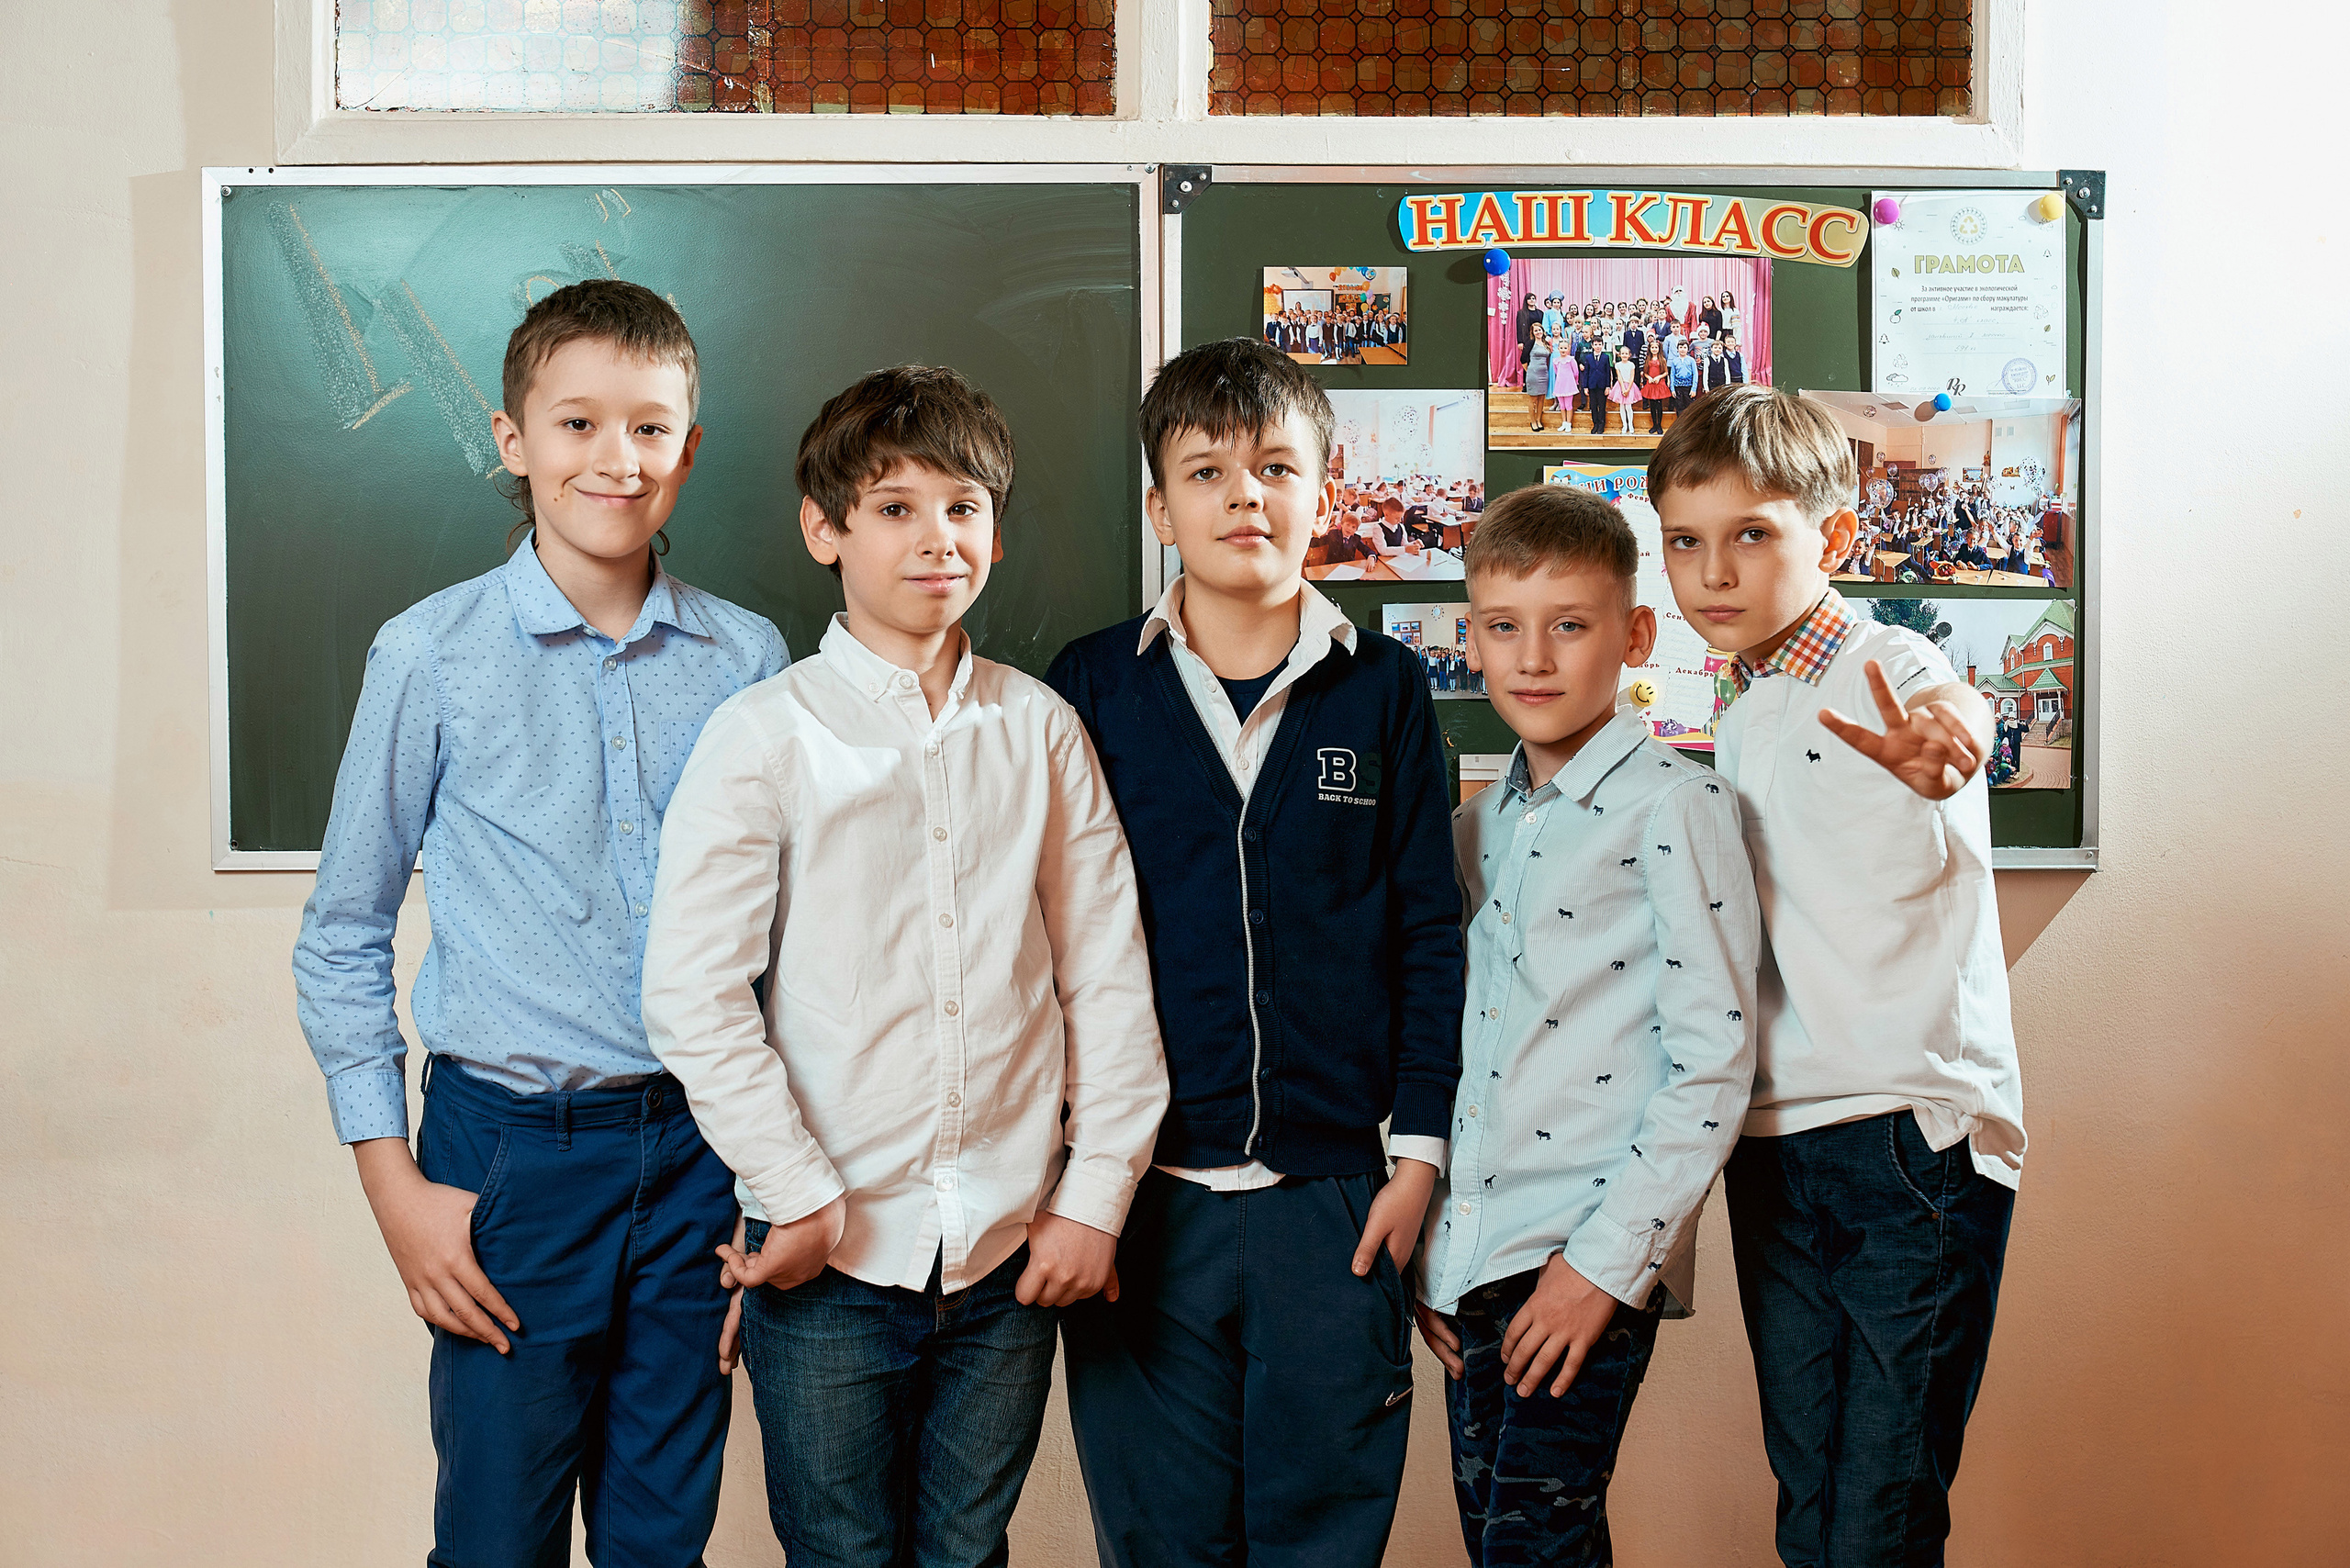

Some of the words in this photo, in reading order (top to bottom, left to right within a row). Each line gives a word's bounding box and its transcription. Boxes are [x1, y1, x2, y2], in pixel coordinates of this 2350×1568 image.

[1407, 192, 1595, 248] НАШ
[1608, 191, 1861, 264] КЛАСС
[1914, 254, 2025, 274] ГРАМОТА
[1675, 667, 1714, 678] Декабрь
[1317, 747, 1357, 791] B
[1318, 793, 1341, 802] BACK
[1343, 796, 1353, 804] TO
